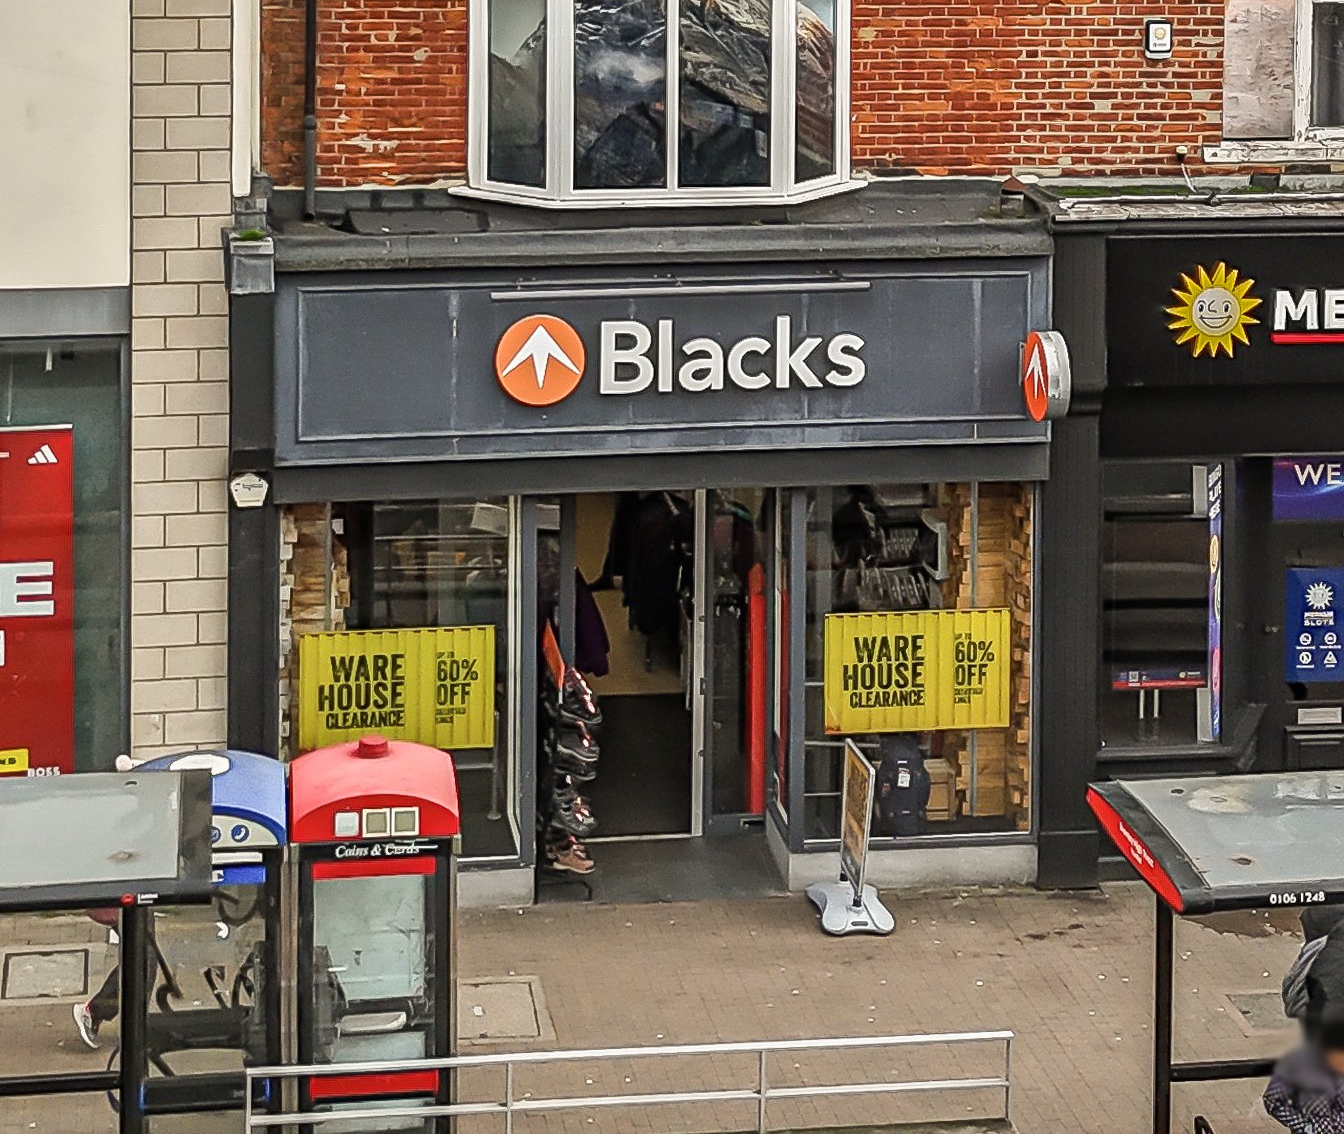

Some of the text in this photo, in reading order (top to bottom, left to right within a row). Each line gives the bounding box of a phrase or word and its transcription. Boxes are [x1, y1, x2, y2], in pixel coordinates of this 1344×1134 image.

[598, 314, 867, 396] Blacks
[854, 635, 925, 663] WARE
[955, 641, 995, 663] 60%
[330, 654, 404, 683] WARE
[437, 659, 479, 682] 60%
[843, 662, 925, 691] HOUSE
[955, 663, 988, 686] OFF
[318, 681, 404, 711] HOUSE
[437, 682, 471, 706] OFF
[850, 690, 925, 709] CLEARANCE
[326, 710, 404, 730] CLEARANCE
[370, 844, 382, 857] &
[1269, 891, 1326, 905] 0106 1248
